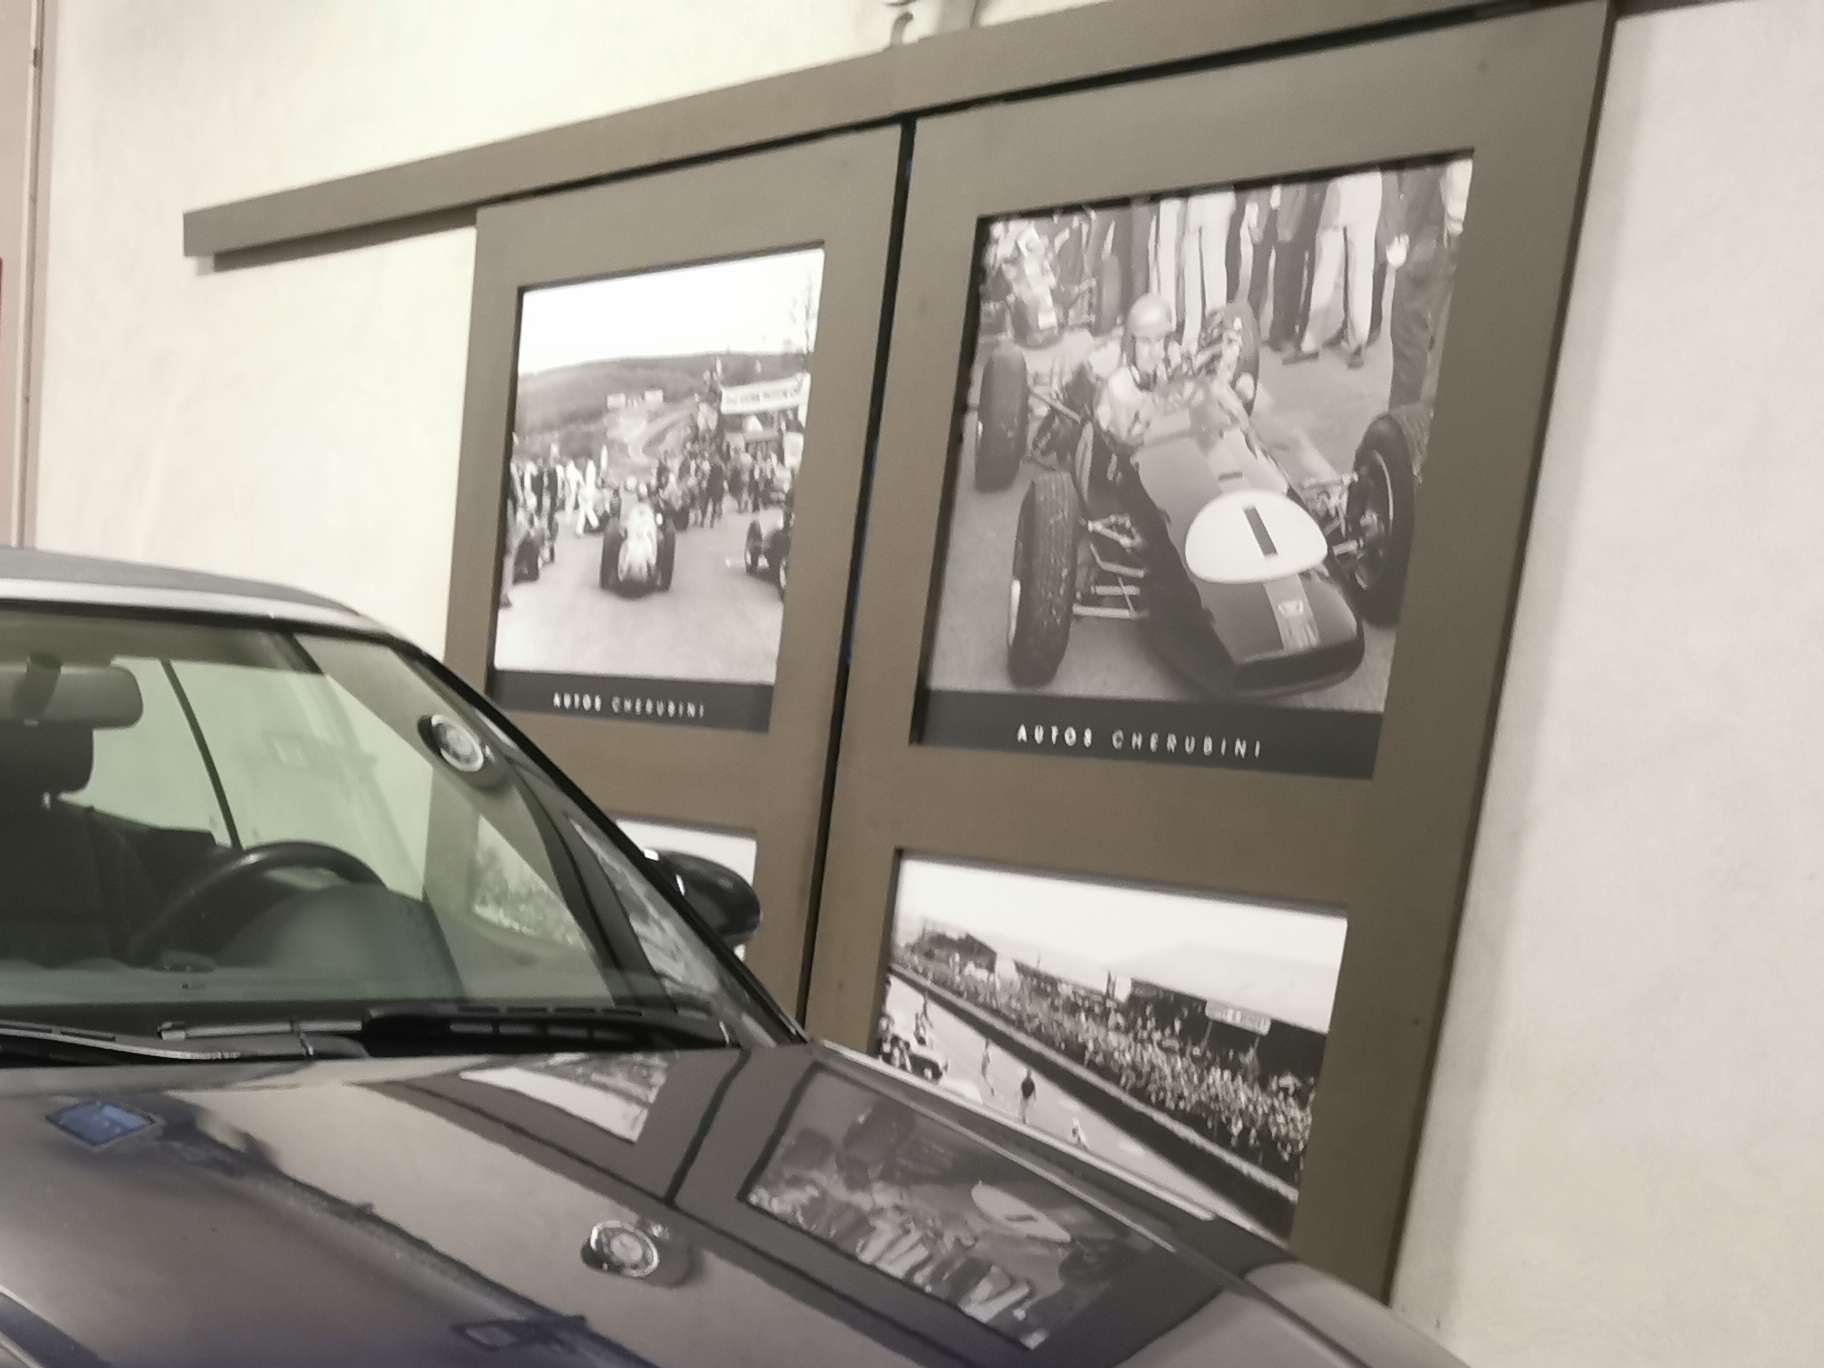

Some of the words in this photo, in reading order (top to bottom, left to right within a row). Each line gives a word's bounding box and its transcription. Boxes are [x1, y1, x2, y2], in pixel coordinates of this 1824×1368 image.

[553, 692, 601, 711] AUTOS
[1017, 724, 1092, 748] AUTOS
[1112, 729, 1260, 758] CHERUBINI
